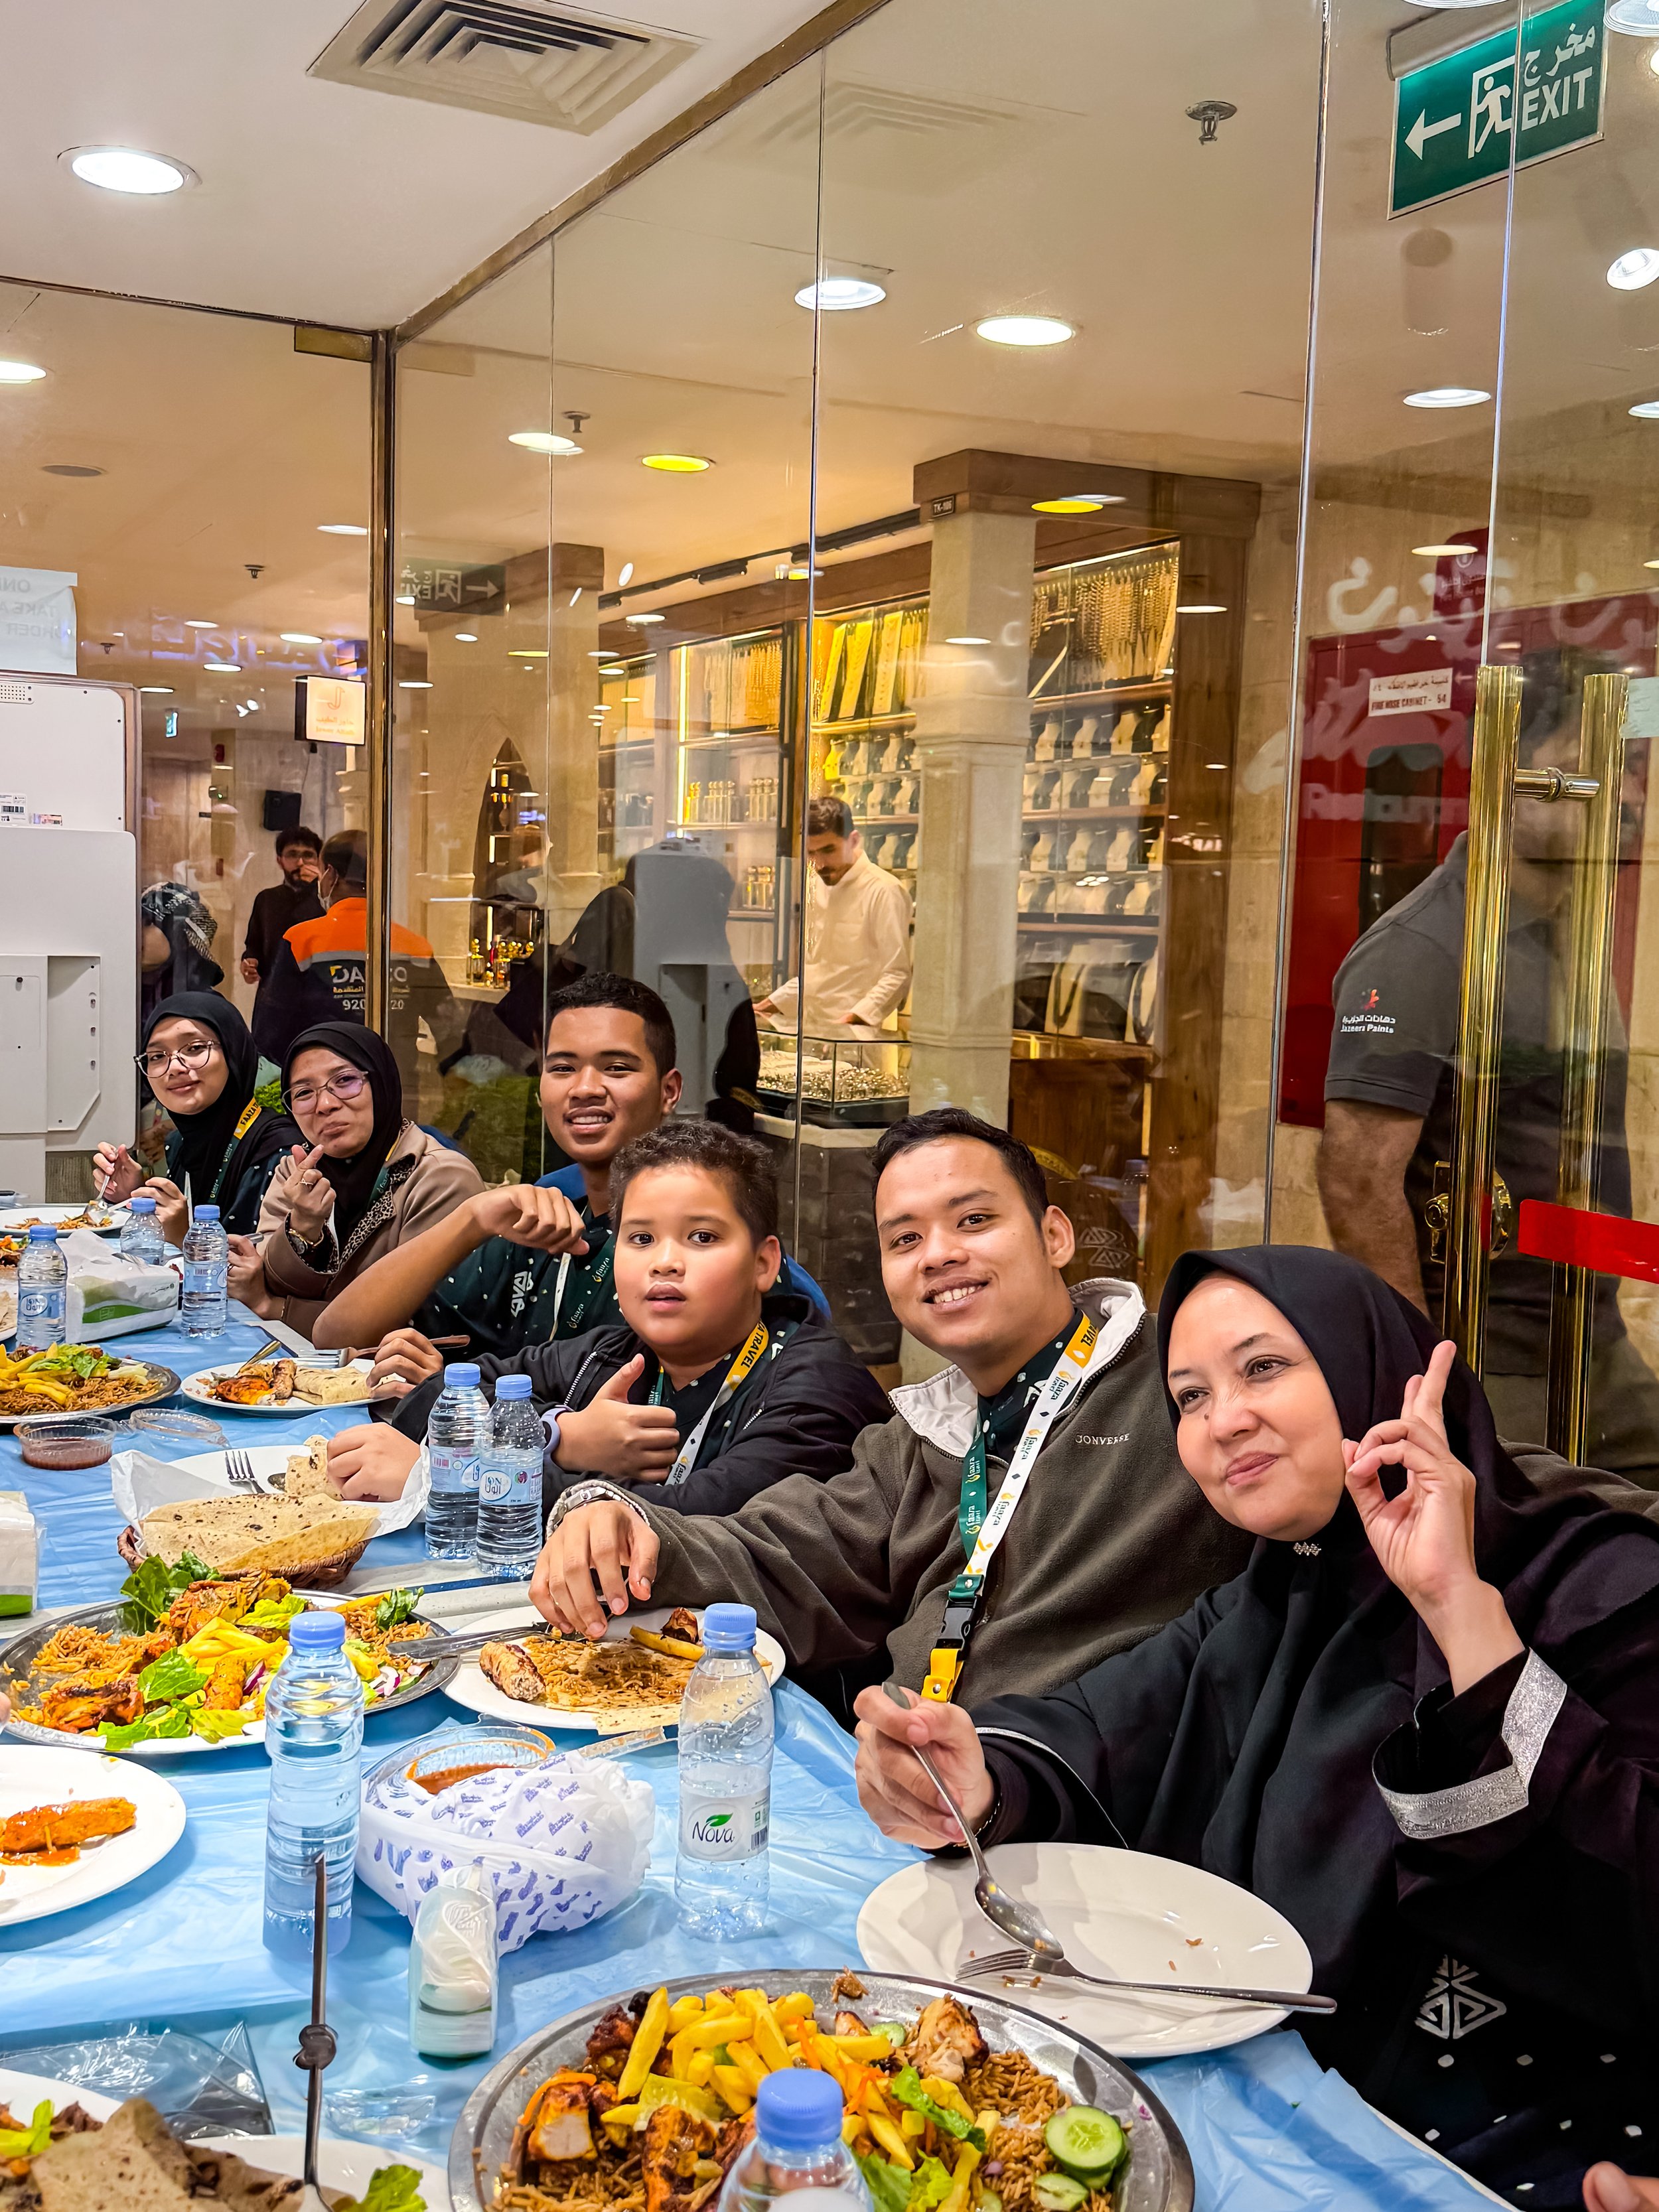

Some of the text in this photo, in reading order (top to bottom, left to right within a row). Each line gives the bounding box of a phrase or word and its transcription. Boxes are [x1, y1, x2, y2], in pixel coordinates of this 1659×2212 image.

[1524, 23, 1596, 88] مخرج
[1521, 66, 1593, 131] EXIT
[1367, 1024, 1394, 1034] Paints
[240, 1107, 258, 1126] FAAZA
[741, 1332, 764, 1369] TRAVEL
[691, 1821, 735, 1844] Nova
